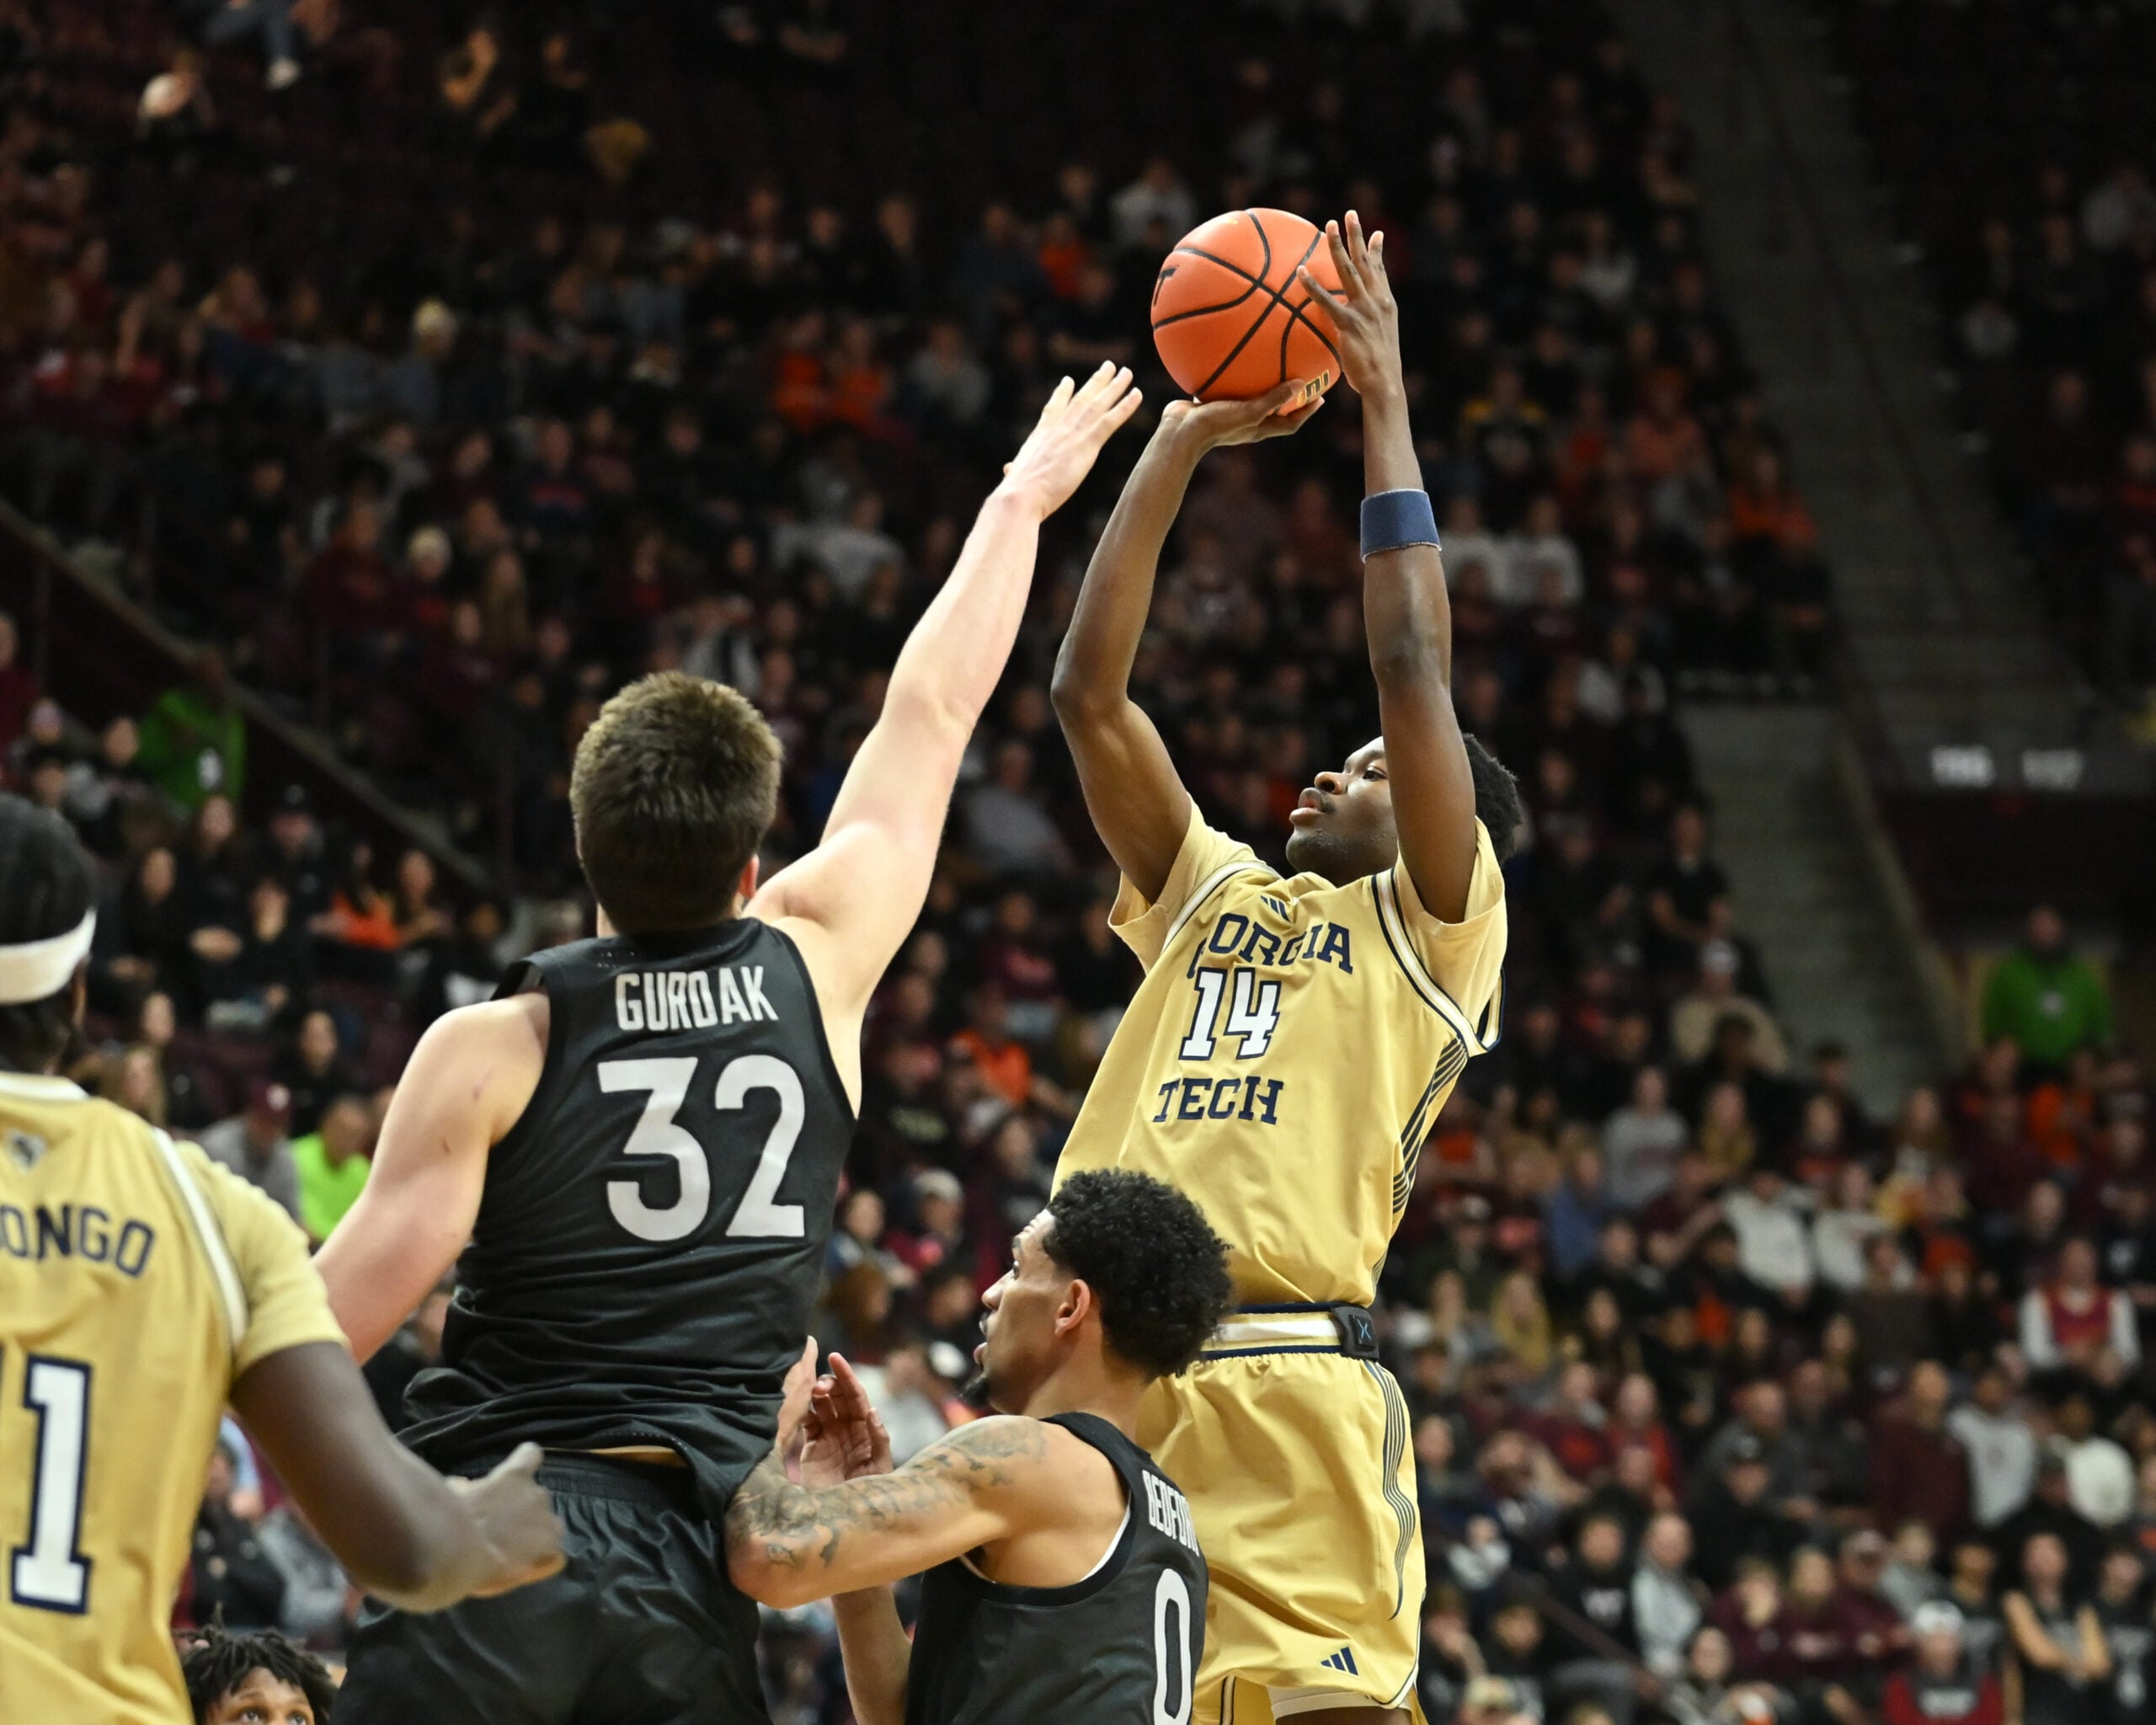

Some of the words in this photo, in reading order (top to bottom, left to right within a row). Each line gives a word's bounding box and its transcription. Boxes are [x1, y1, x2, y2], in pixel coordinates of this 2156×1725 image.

[1187, 913, 1353, 980] ORGIA
[615, 965, 780, 1031] GURDAK
[1178, 966, 1282, 1061] 14
[1152, 1075, 1285, 1126] TECH
[597, 1054, 805, 1242] 32
[0, 1204, 155, 1279] ONGO
[0, 1351, 93, 1615] 1
[1153, 1567, 1193, 1725] 0
